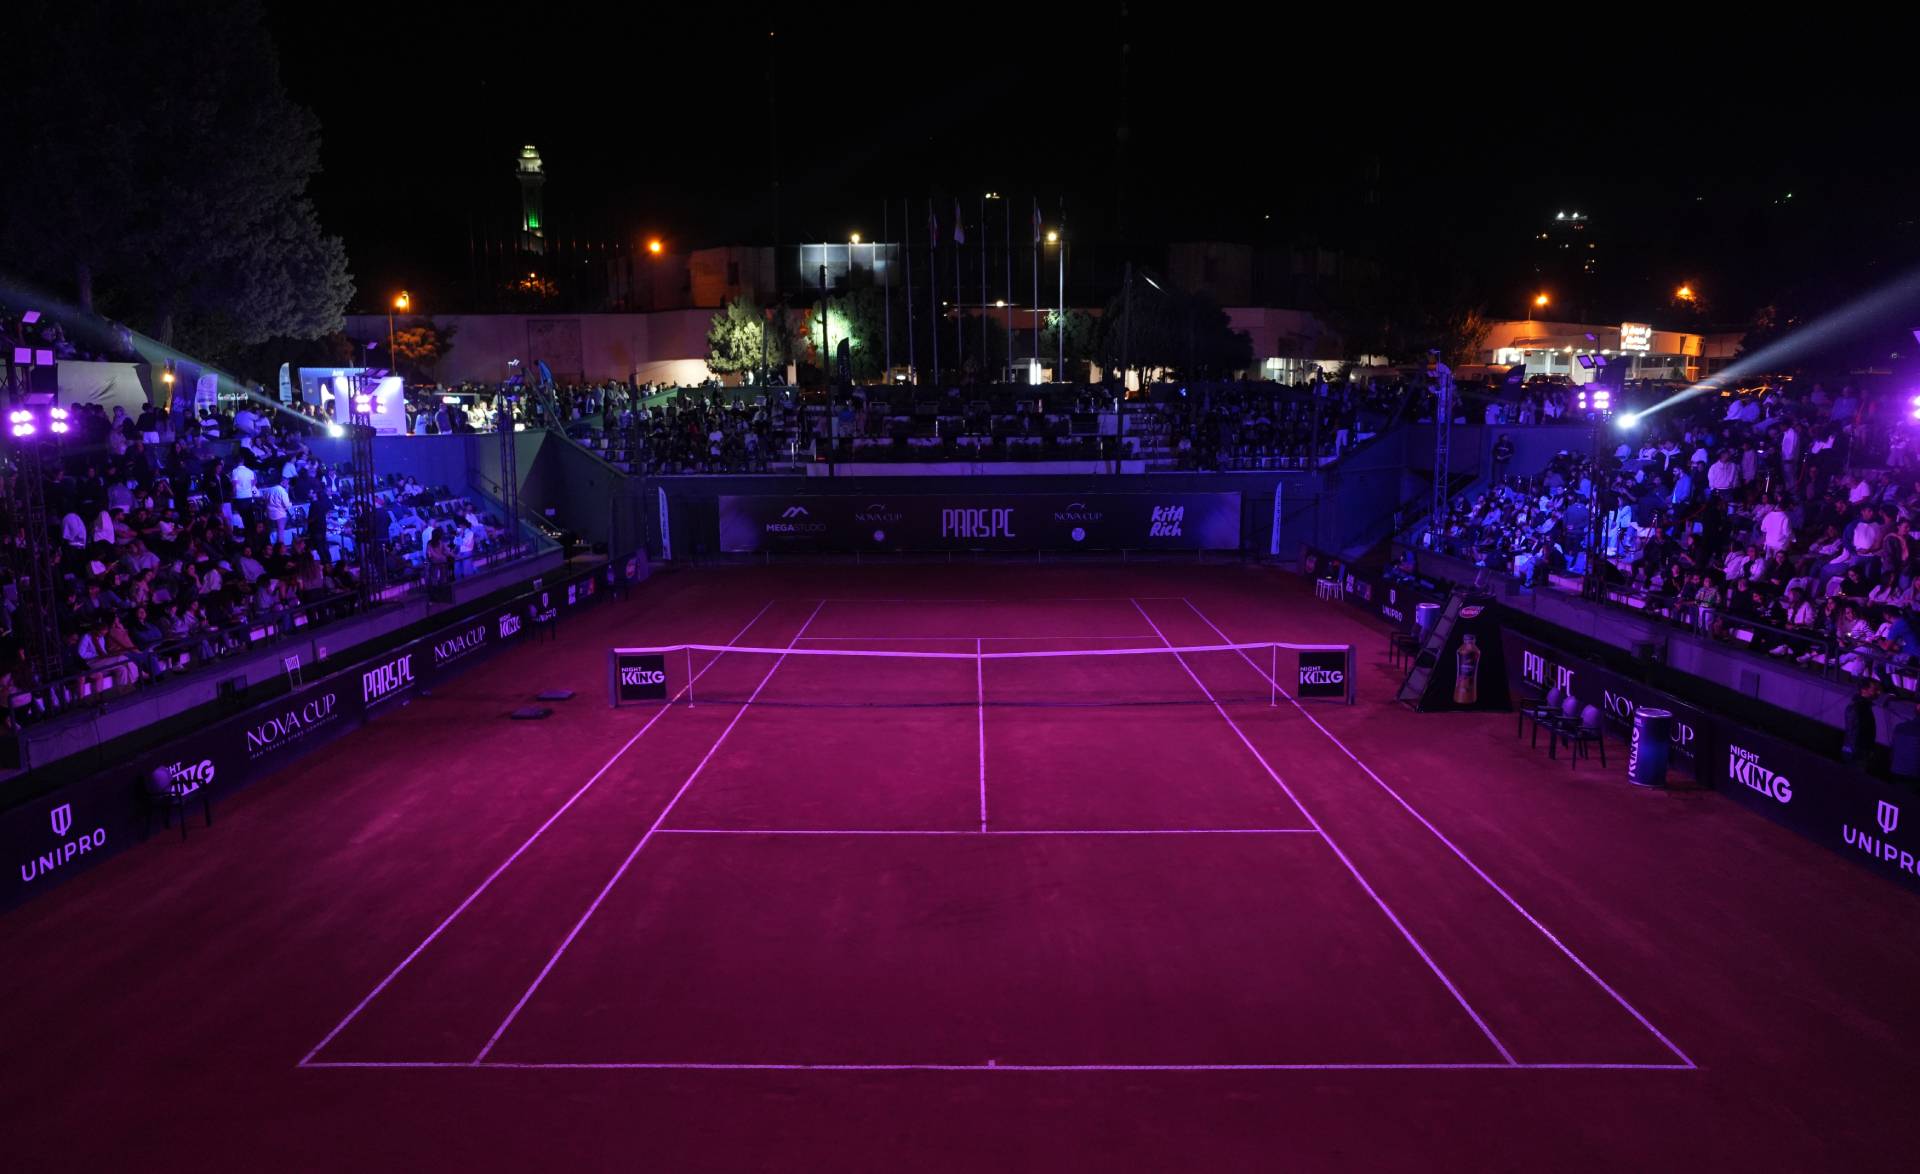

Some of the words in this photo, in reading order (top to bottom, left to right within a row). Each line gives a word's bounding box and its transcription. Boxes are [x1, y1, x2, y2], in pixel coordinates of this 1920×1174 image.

[434, 636, 466, 662] NOVA
[467, 625, 486, 645] CUP
[622, 670, 665, 685] KING
[1300, 670, 1343, 684] KING
[247, 712, 301, 752] NOVA
[303, 693, 336, 723] CUP
[1730, 744, 1760, 763] NIGHT
[1729, 754, 1792, 804] KING
[21, 828, 106, 882] UNIPRO
[1843, 824, 1920, 877] UNIPR
